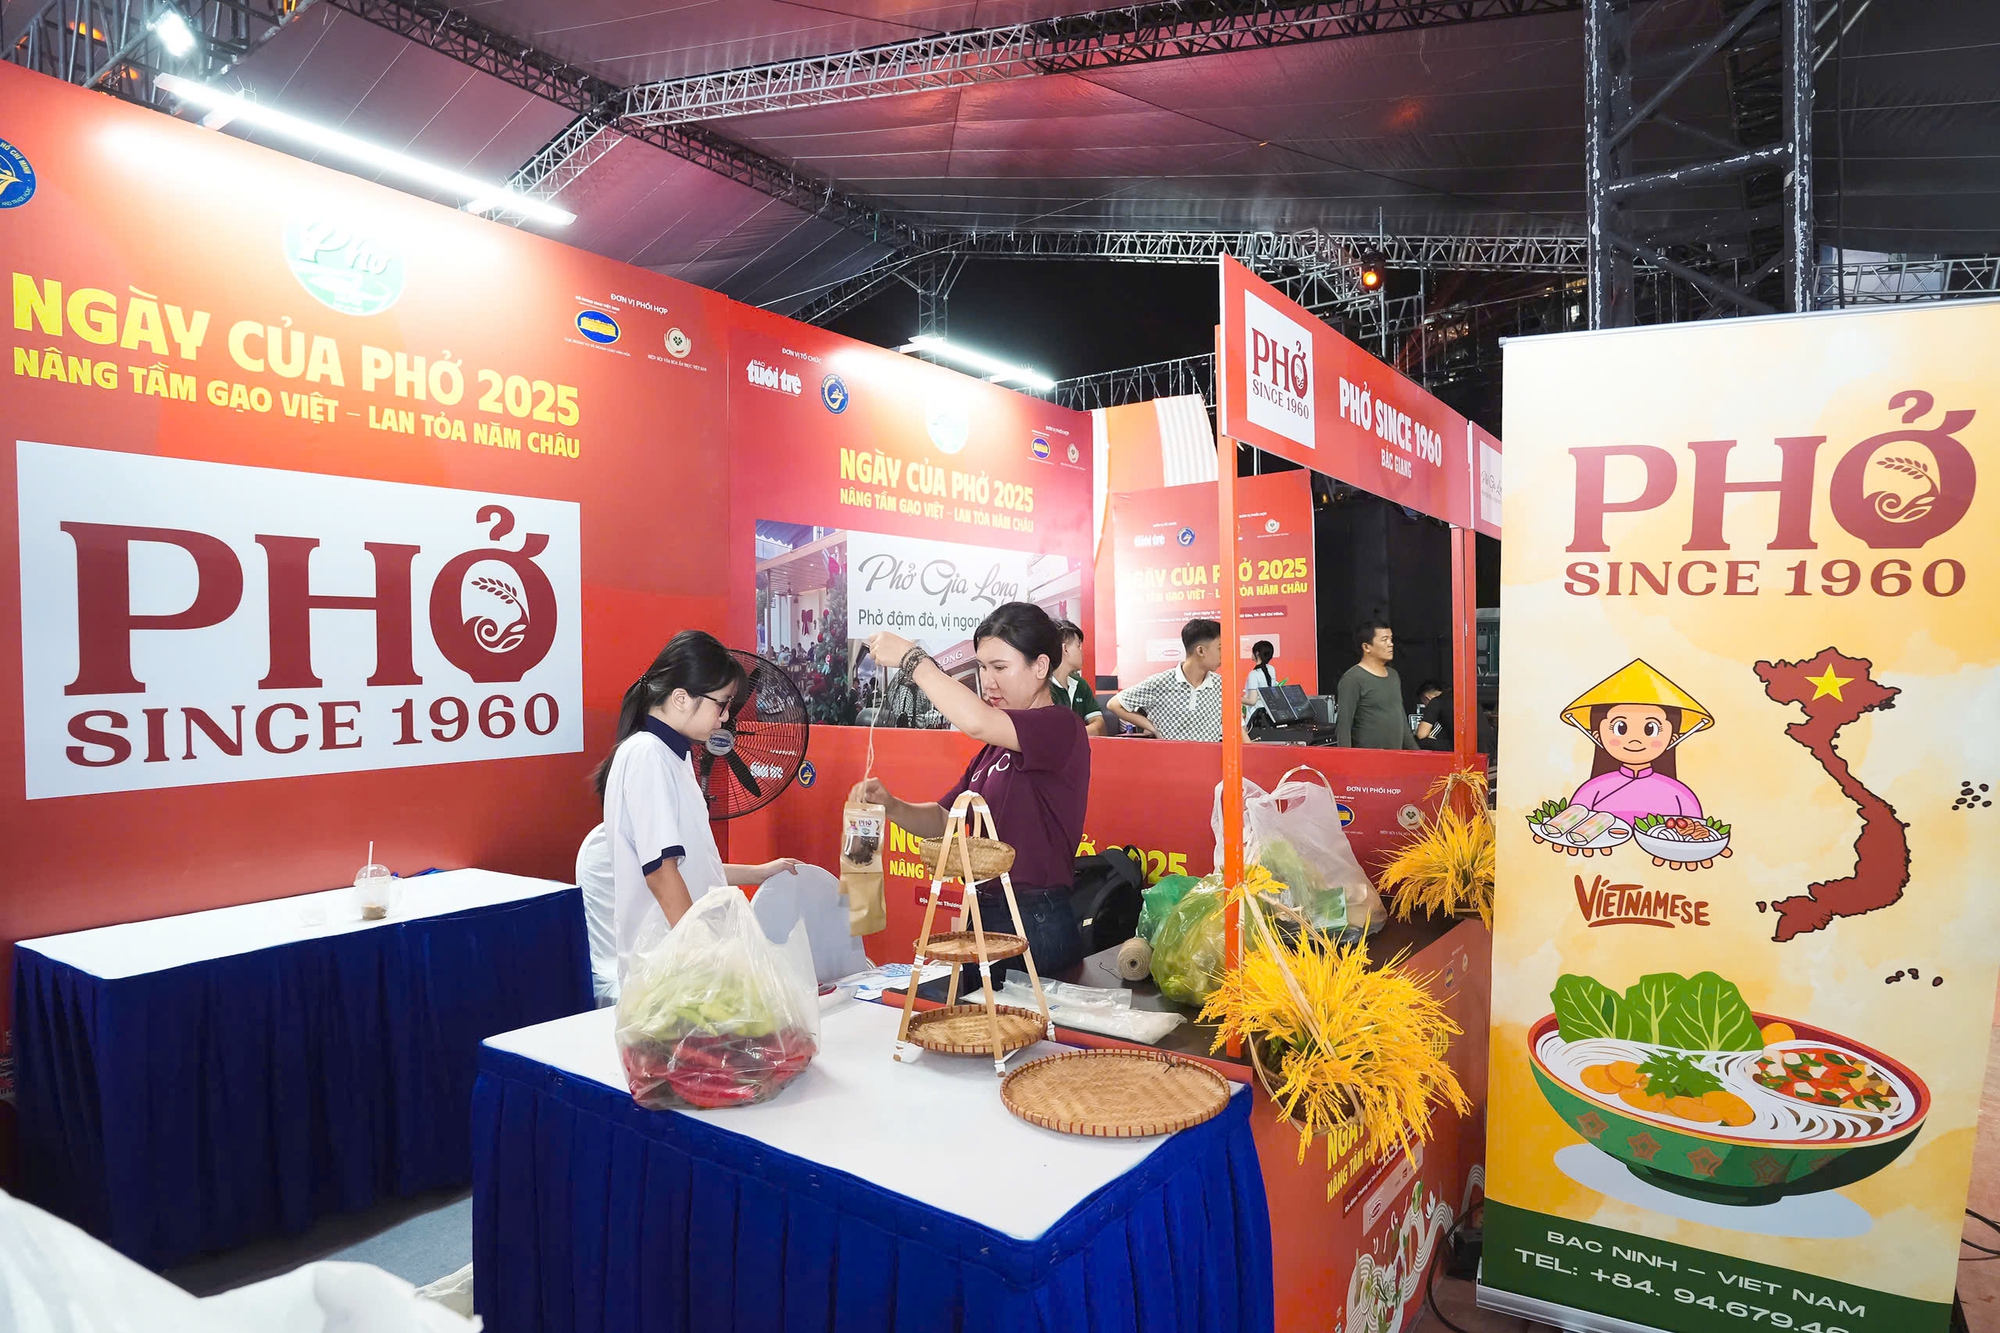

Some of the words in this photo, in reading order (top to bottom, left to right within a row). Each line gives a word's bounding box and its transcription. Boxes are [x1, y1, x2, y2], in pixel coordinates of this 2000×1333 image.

[12, 272, 210, 363] NGÀY
[227, 316, 345, 386] CỦA
[361, 350, 464, 406] PHỞ
[478, 368, 580, 427] 2025
[1252, 327, 1308, 399] PHỞ
[746, 359, 779, 390] tuổi
[779, 368, 802, 395] trẻ
[1253, 379, 1284, 408] SINCE
[1287, 397, 1309, 420] 1960
[13, 346, 119, 390] NÂNG
[133, 361, 197, 403] TẦM
[206, 379, 272, 415] GẠO
[281, 391, 337, 424] VIỆT
[368, 410, 416, 436] LAN
[423, 411, 467, 444] TỎA
[473, 421, 521, 453] NĂM
[527, 425, 580, 459] CHÂU
[1339, 376, 1372, 431] PHỞ
[1375, 398, 1412, 453] SINCE
[1414, 422, 1442, 467] 1960
[840, 447, 901, 489] NGÀY
[906, 457, 947, 498] CỦA
[951, 470, 990, 505] PHỞ
[994, 480, 1034, 513] 2025
[1395, 455, 1412, 479] GIANG
[1565, 389, 1976, 553] PHỞ
[840, 486, 872, 508] NÂNG
[874, 490, 897, 512] TẦM
[899, 498, 922, 518] GẠO
[923, 501, 944, 521] VIỆT
[954, 507, 972, 523] LAN
[858, 553, 916, 592] Phở
[920, 559, 968, 606] Gia
[970, 562, 1019, 607] Long
[1125, 565, 1167, 588] GÀY
[1170, 562, 1207, 587] CỦA
[1258, 557, 1307, 581] 2025
[1186, 588, 1205, 601] VIỆT
[1239, 584, 1254, 598] ỎA
[1256, 583, 1279, 597] NĂM
[1281, 582, 1308, 595] CHÂU
[1564, 560, 1760, 597] SINCE
[1785, 558, 1966, 598] 1960
[60, 504, 558, 695] PHỞ
[858, 608, 883, 626] Phở
[886, 611, 916, 630] đậm
[918, 612, 938, 630] đà,
[941, 615, 951, 631] vị
[953, 616, 980, 631] ngon
[65, 699, 363, 768] SINCE
[392, 692, 560, 745] 1960
[889, 858, 924, 879] NÂNG
[1327, 1164, 1348, 1203] NÂNG
[1514, 1247, 1578, 1277] TEL:
[1590, 1268, 1661, 1297] +84.
[1546, 1230, 1603, 1254] BAC
[1611, 1246, 1678, 1273] NINH
[1716, 1271, 1782, 1295] VIET
[1793, 1288, 1866, 1318] NAM
